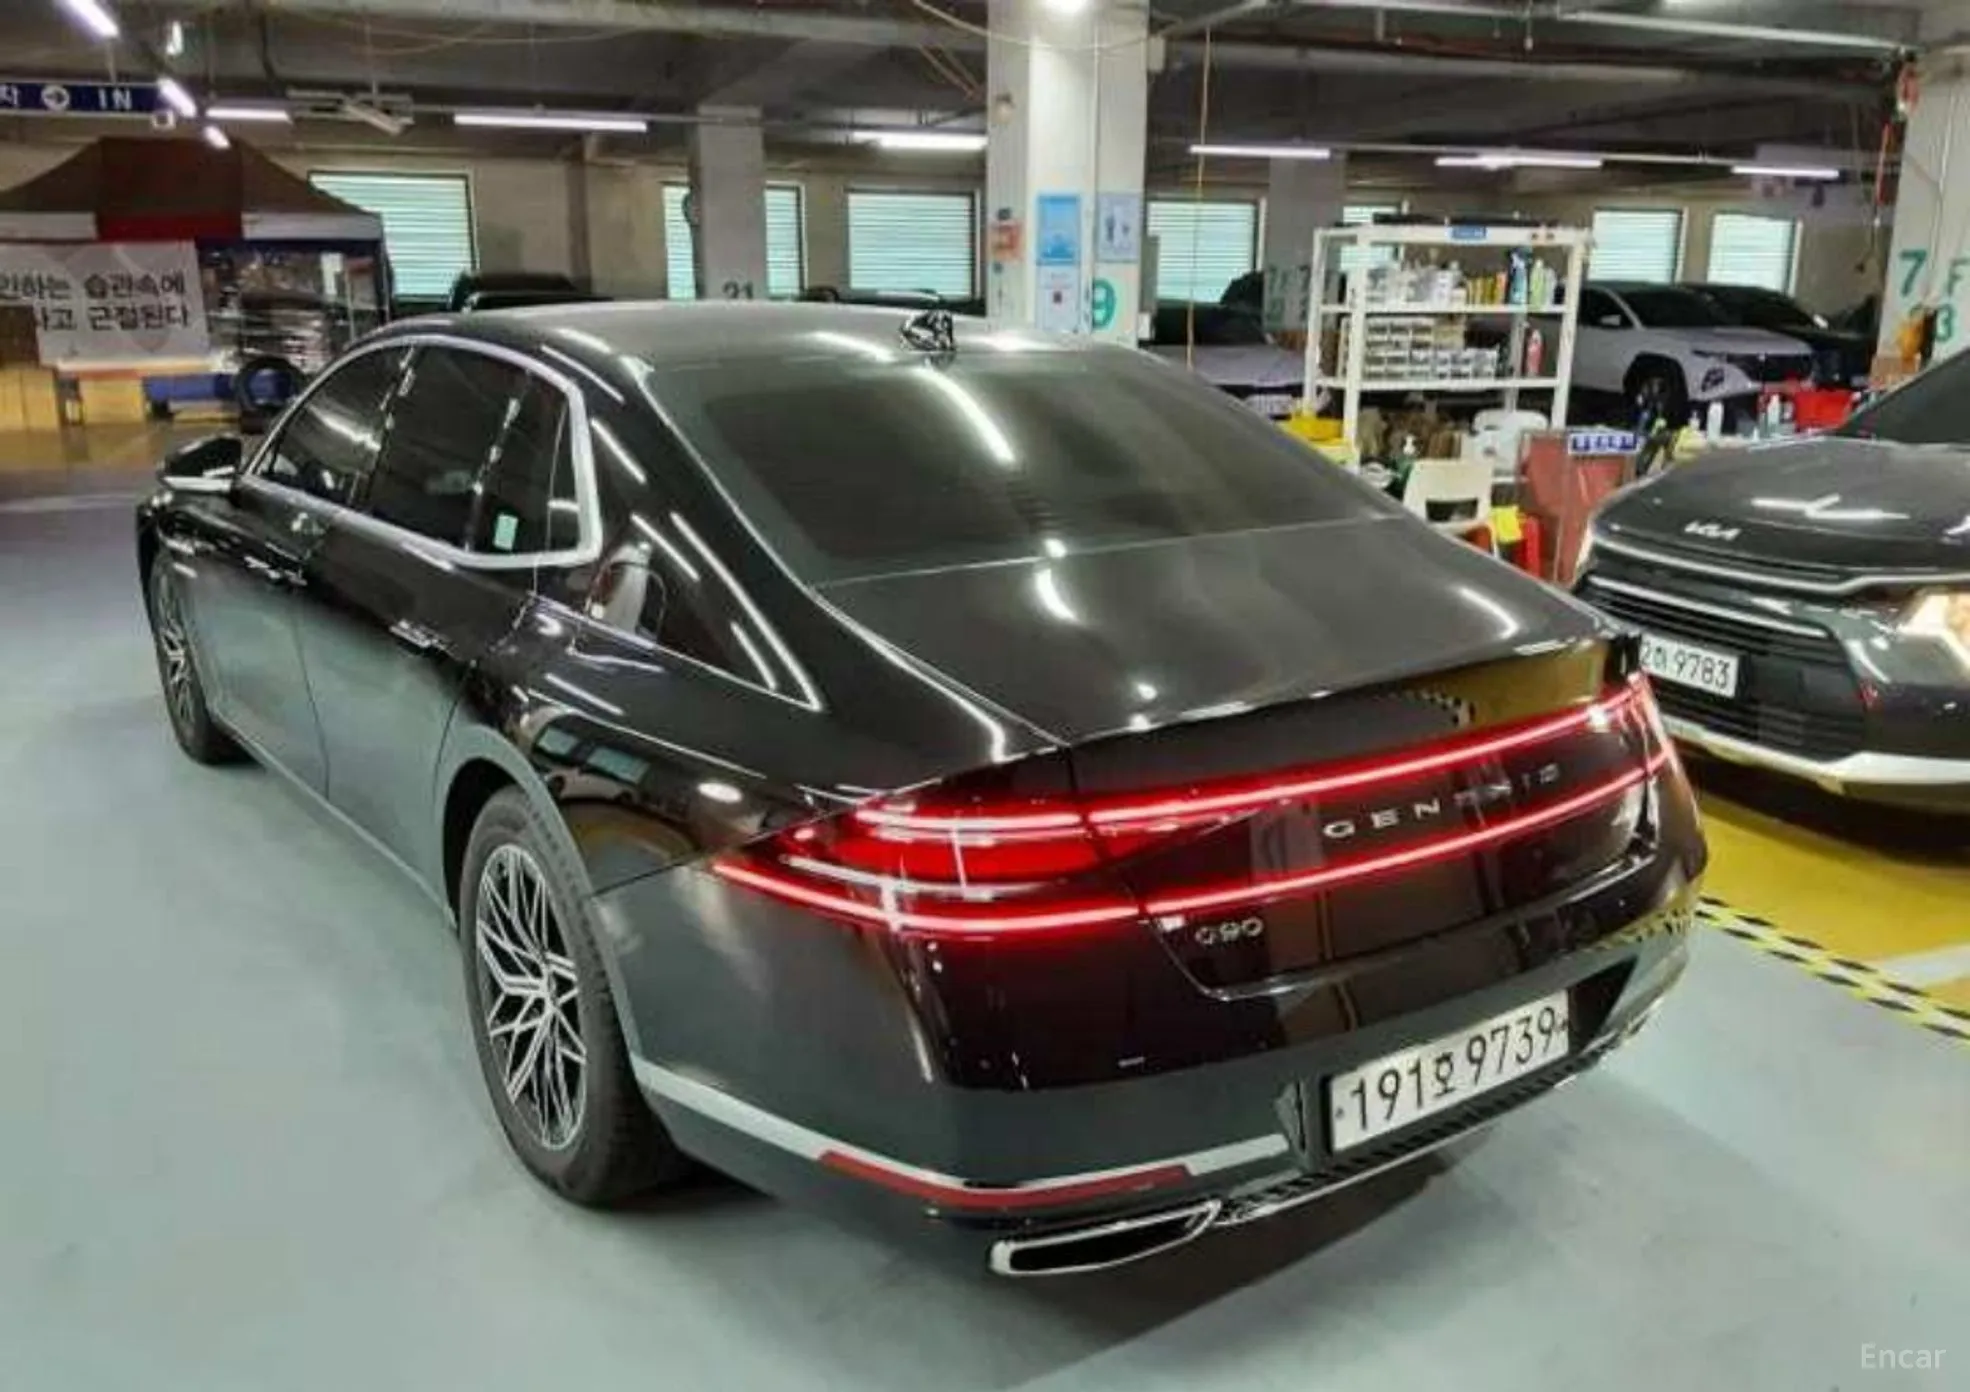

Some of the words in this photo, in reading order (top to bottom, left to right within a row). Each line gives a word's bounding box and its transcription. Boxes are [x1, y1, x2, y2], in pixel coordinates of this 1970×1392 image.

[98, 87, 133, 110] IN
[1084, 278, 1117, 329] 9
[1465, 1006, 1557, 1086] 9739
